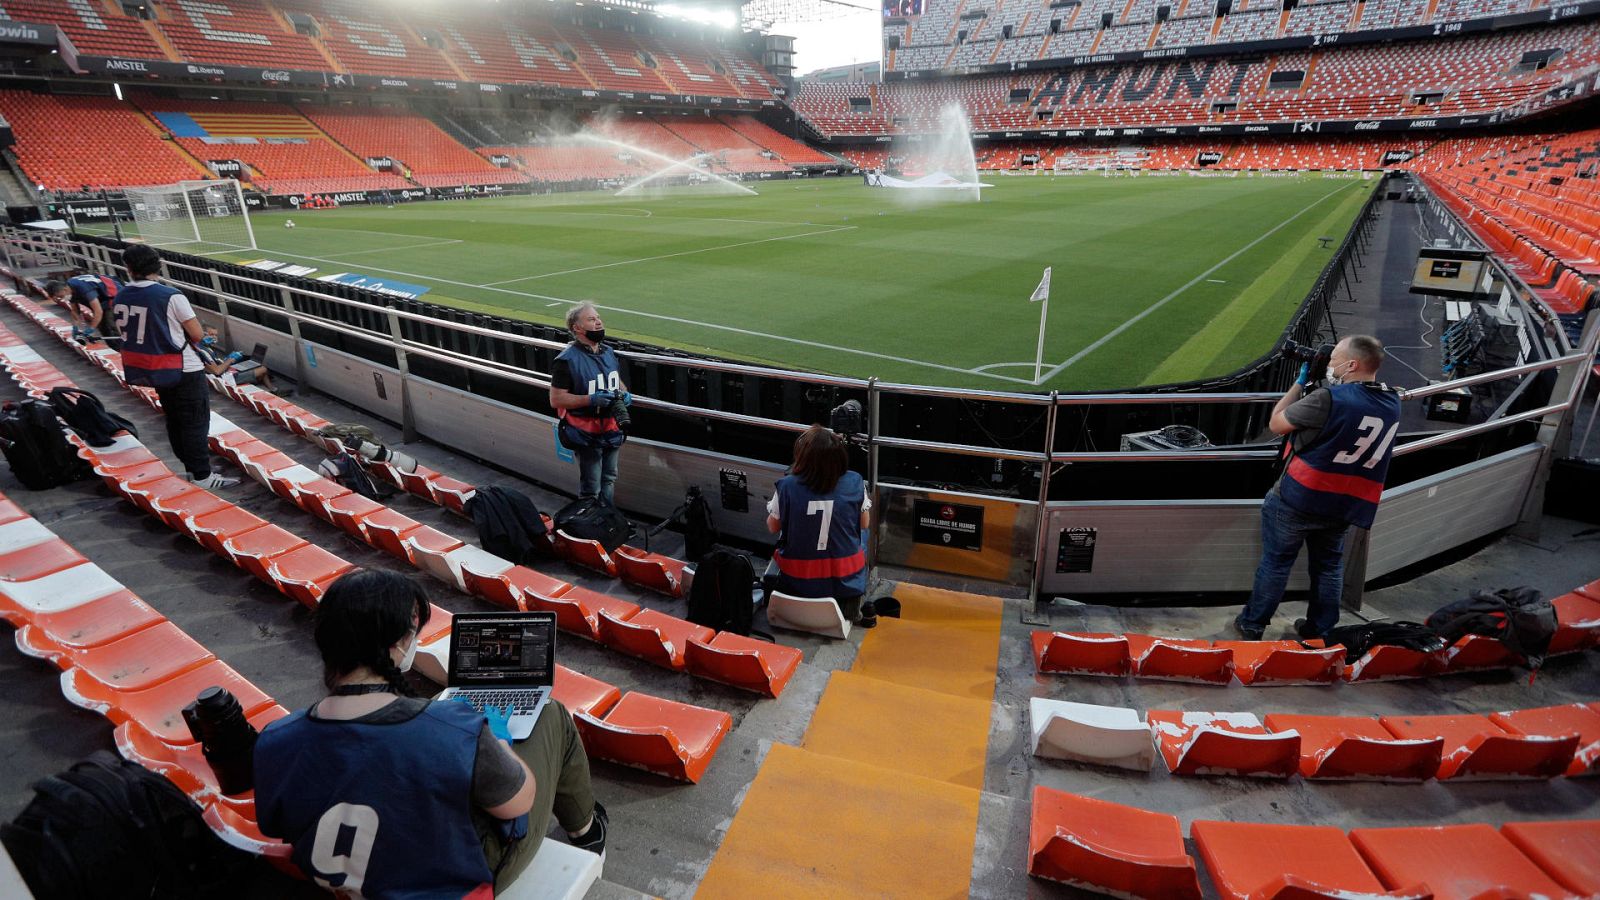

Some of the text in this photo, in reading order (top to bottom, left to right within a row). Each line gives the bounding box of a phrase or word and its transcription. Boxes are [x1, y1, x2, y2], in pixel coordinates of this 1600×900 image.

[106, 60, 148, 71] AMSTEL
[196, 66, 225, 75] Libertex
[1410, 120, 1437, 128] AMSTEL
[1095, 128, 1115, 136] bwin
[1200, 153, 1219, 161] bwin
[1386, 152, 1409, 160] bwin
[212, 161, 240, 171] bwin
[370, 158, 392, 167] bwin
[334, 192, 365, 202] AMSTEL
[114, 303, 148, 344] 27
[1333, 416, 1400, 469] 31
[806, 500, 834, 550] 7
[311, 801, 380, 900] 9
